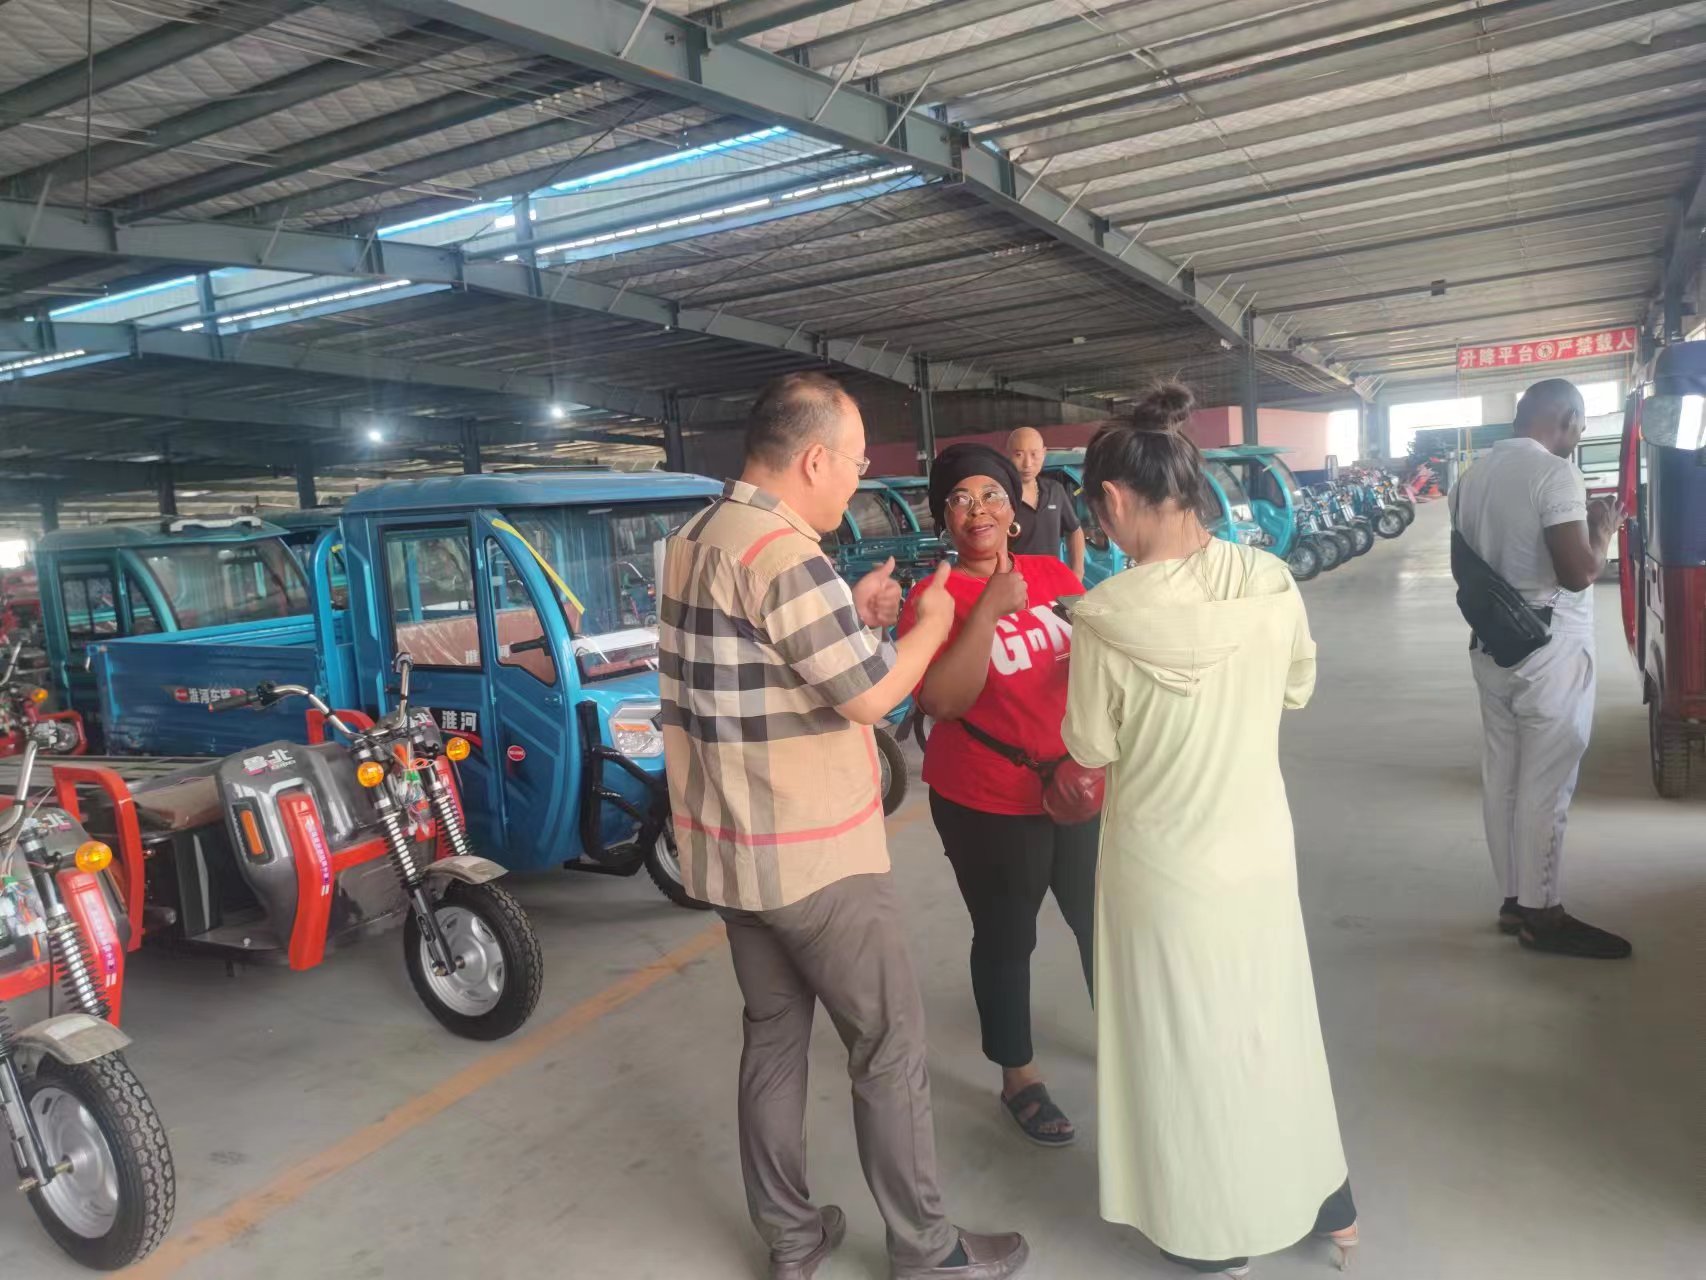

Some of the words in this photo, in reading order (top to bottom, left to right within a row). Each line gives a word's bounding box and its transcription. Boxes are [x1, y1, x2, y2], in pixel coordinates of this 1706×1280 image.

[1461, 346, 1533, 368] 升降平台
[1556, 331, 1632, 358] 严禁载人
[442, 710, 477, 732] 淮河
